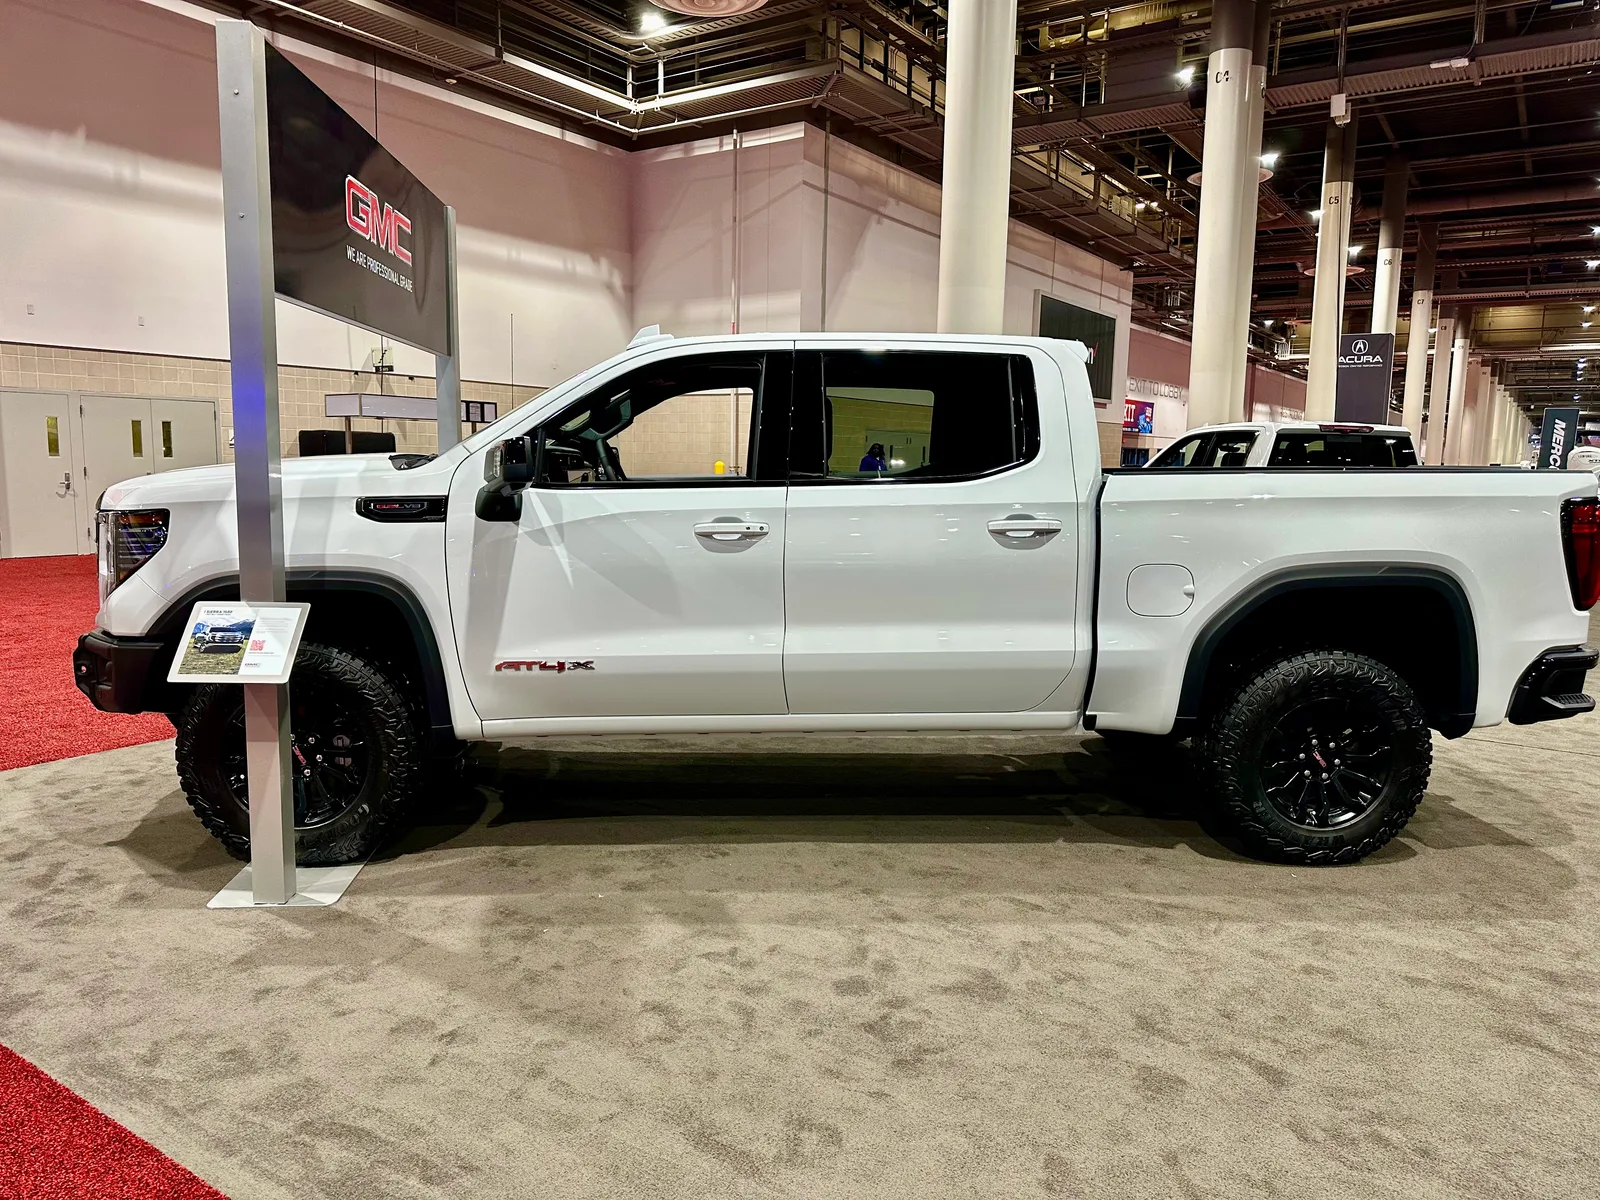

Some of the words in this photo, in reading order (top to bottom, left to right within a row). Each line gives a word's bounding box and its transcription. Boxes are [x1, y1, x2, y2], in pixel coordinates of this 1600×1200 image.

[1215, 70, 1230, 84] C4
[1328, 196, 1340, 205] C5
[345, 174, 412, 267] GMC
[346, 244, 356, 262] WE
[356, 250, 367, 268] ARE
[366, 256, 400, 286] PROFESSIONAL
[399, 274, 413, 293] GRADE
[1383, 258, 1393, 266] C6
[1338, 355, 1383, 363] ACURA
[1129, 377, 1148, 394] EXIT
[1148, 381, 1160, 396] TO
[1159, 383, 1184, 400] LOBBY
[1124, 403, 1136, 422] XIT
